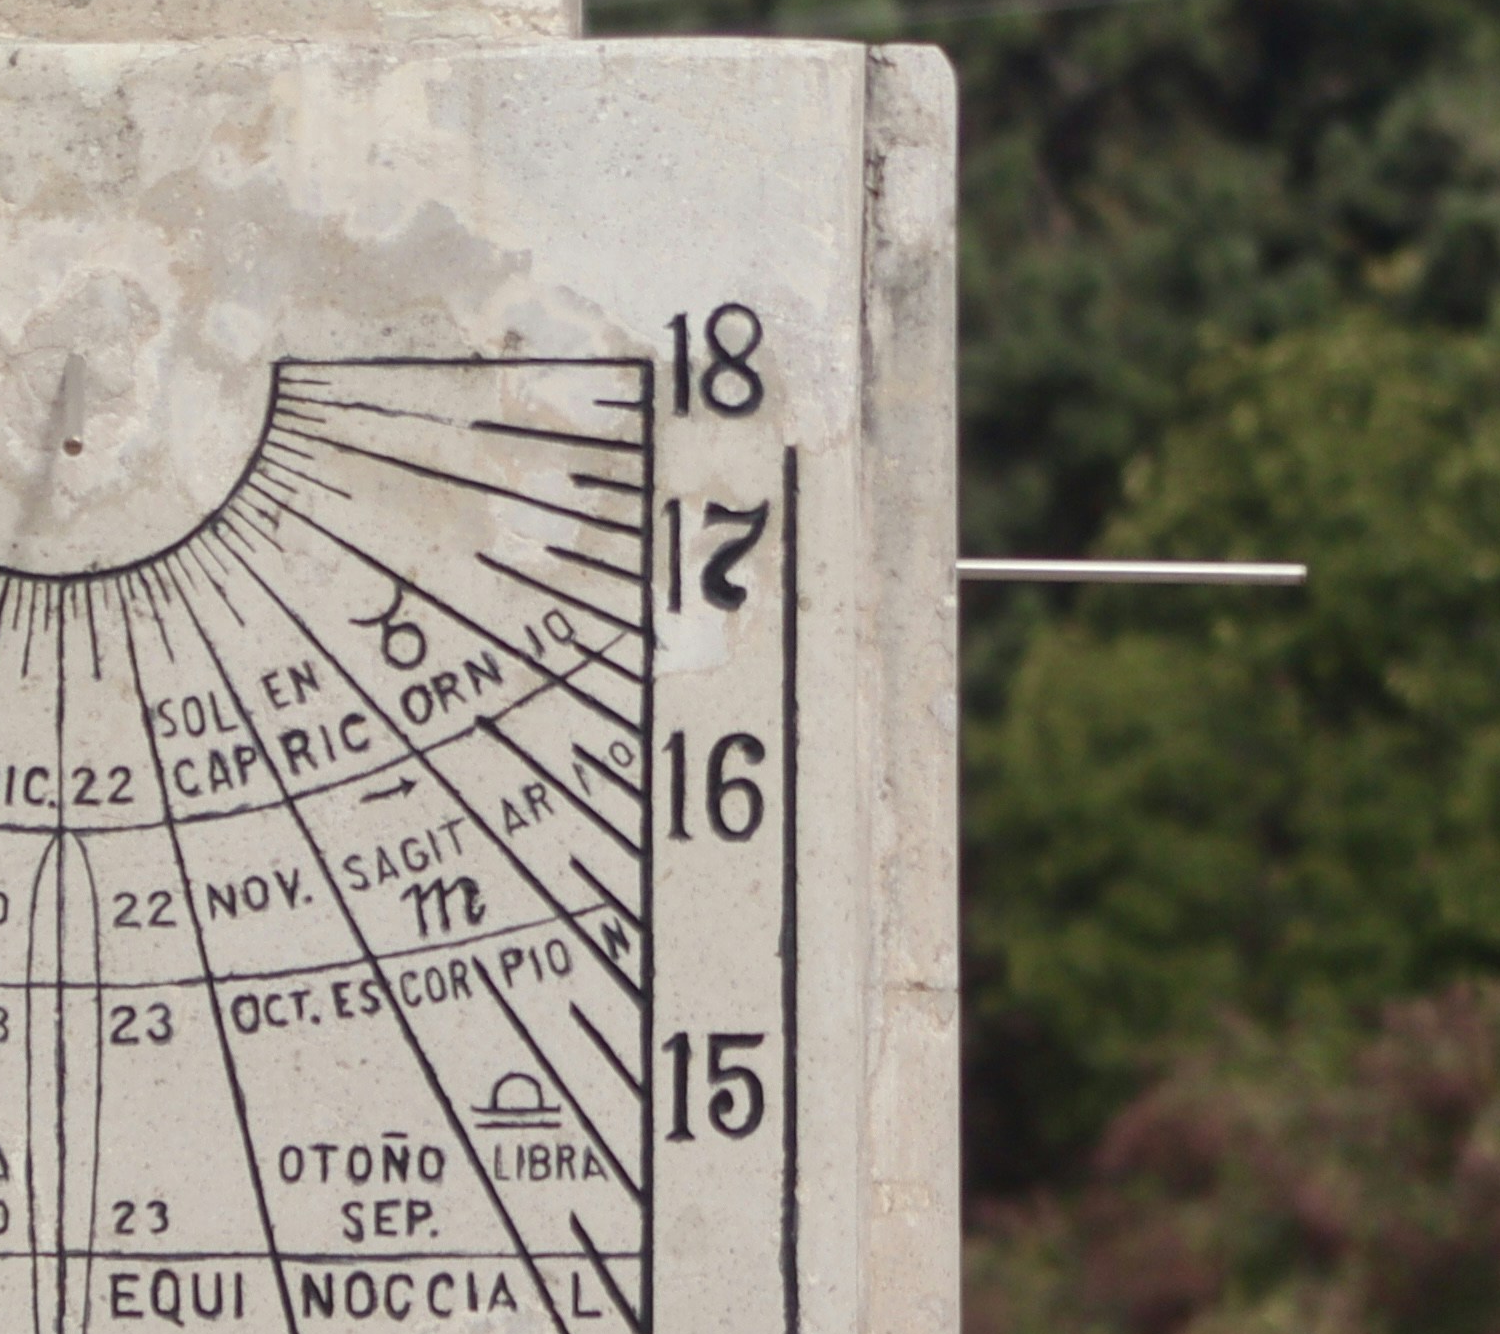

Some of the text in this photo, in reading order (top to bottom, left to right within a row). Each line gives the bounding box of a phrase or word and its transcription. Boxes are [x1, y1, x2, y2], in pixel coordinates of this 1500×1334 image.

[667, 303, 764, 417] 18
[664, 497, 770, 614] 17
[156, 659, 322, 741] SOL EN
[72, 765, 135, 807] 22
[664, 729, 767, 842] 16
[112, 889, 178, 929] 22
[207, 867, 314, 920] NOV.
[109, 1005, 175, 1045] 23
[230, 989, 322, 1035] OCT.
[663, 1030, 767, 1141] 15
[277, 1132, 610, 1184] OTOÑO LIBRA
[112, 1200, 440, 1241] 23 SEP.
